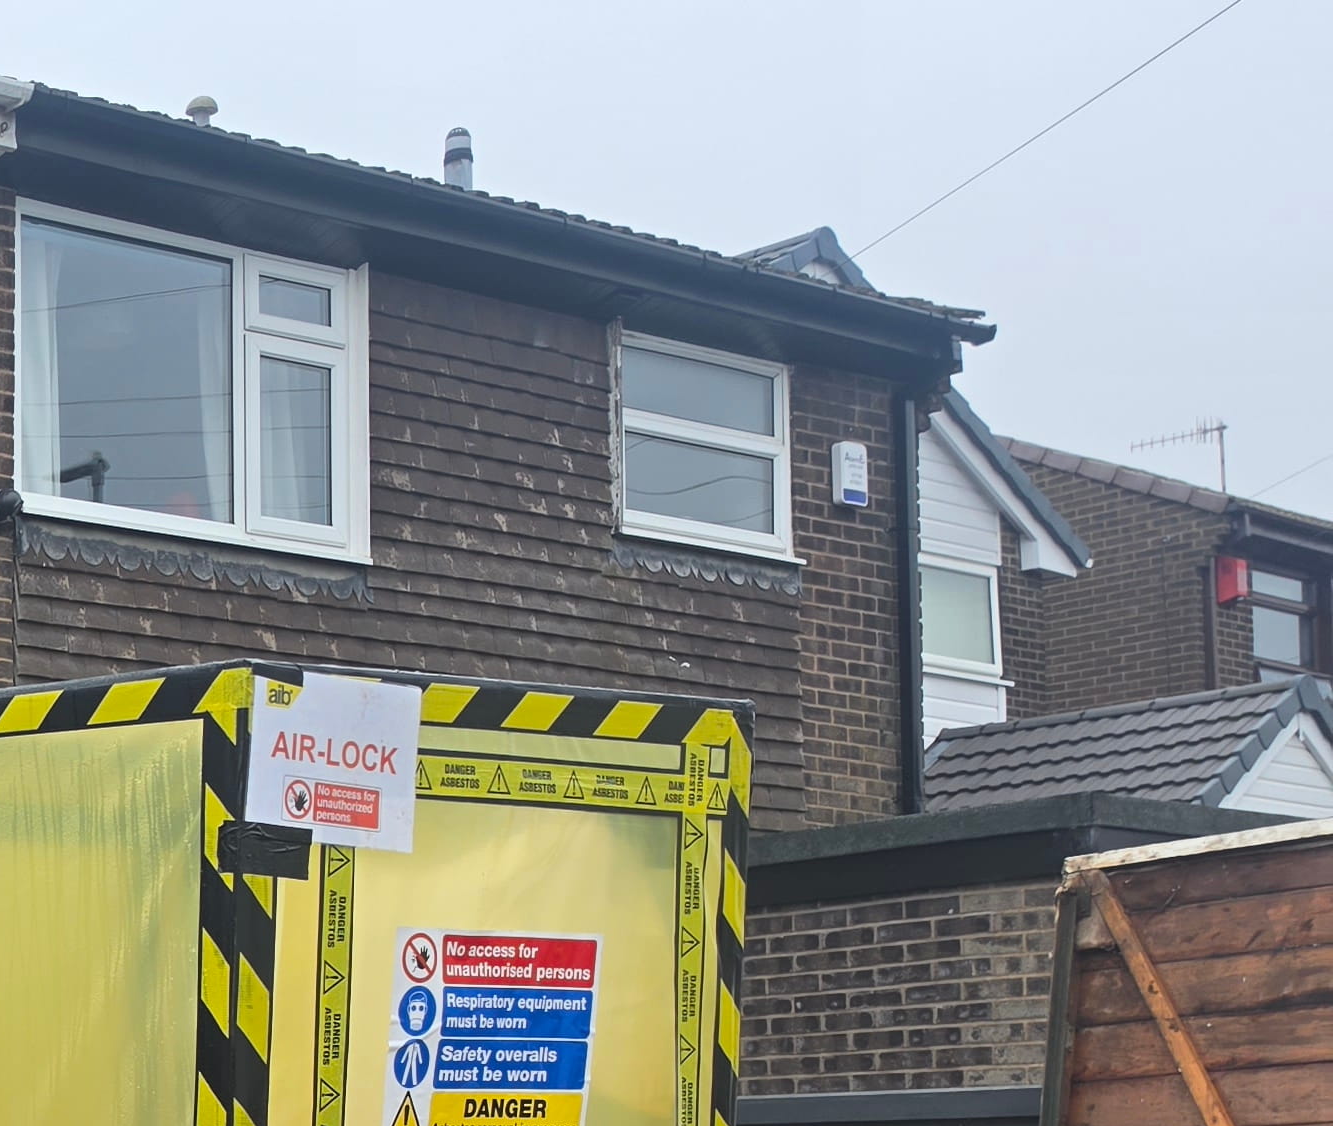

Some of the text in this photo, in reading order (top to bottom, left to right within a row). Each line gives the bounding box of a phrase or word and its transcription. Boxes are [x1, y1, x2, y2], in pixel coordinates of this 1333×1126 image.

[271, 731, 398, 775] AIR-LOCK
[445, 764, 475, 775] DANGER
[522, 769, 552, 780] DANGER
[440, 777, 480, 789] ASBESTOS
[519, 782, 556, 794] ASBESTOS
[596, 775, 624, 786] DANGER
[688, 753, 697, 807] ASBESTOS
[317, 785, 376, 801] No access for
[592, 787, 628, 800] ASBESTOS
[317, 798, 372, 814] unauthorized
[316, 811, 351, 822] persons
[327, 889, 337, 948] ASBESTOS
[337, 896, 346, 942] DANGER
[446, 942, 538, 958] No access for
[446, 963, 591, 982] unauthorised persons
[447, 993, 587, 1012] Respiratory equipment
[689, 975, 697, 1017] DANGER
[446, 1015, 527, 1029] must be worn
[323, 1007, 332, 1065] ASBESTOS
[331, 1013, 341, 1059] DANGER
[441, 1046, 557, 1063] Safety overalls
[439, 1067, 547, 1082] must be worn
[464, 1099, 546, 1118] DANGER
